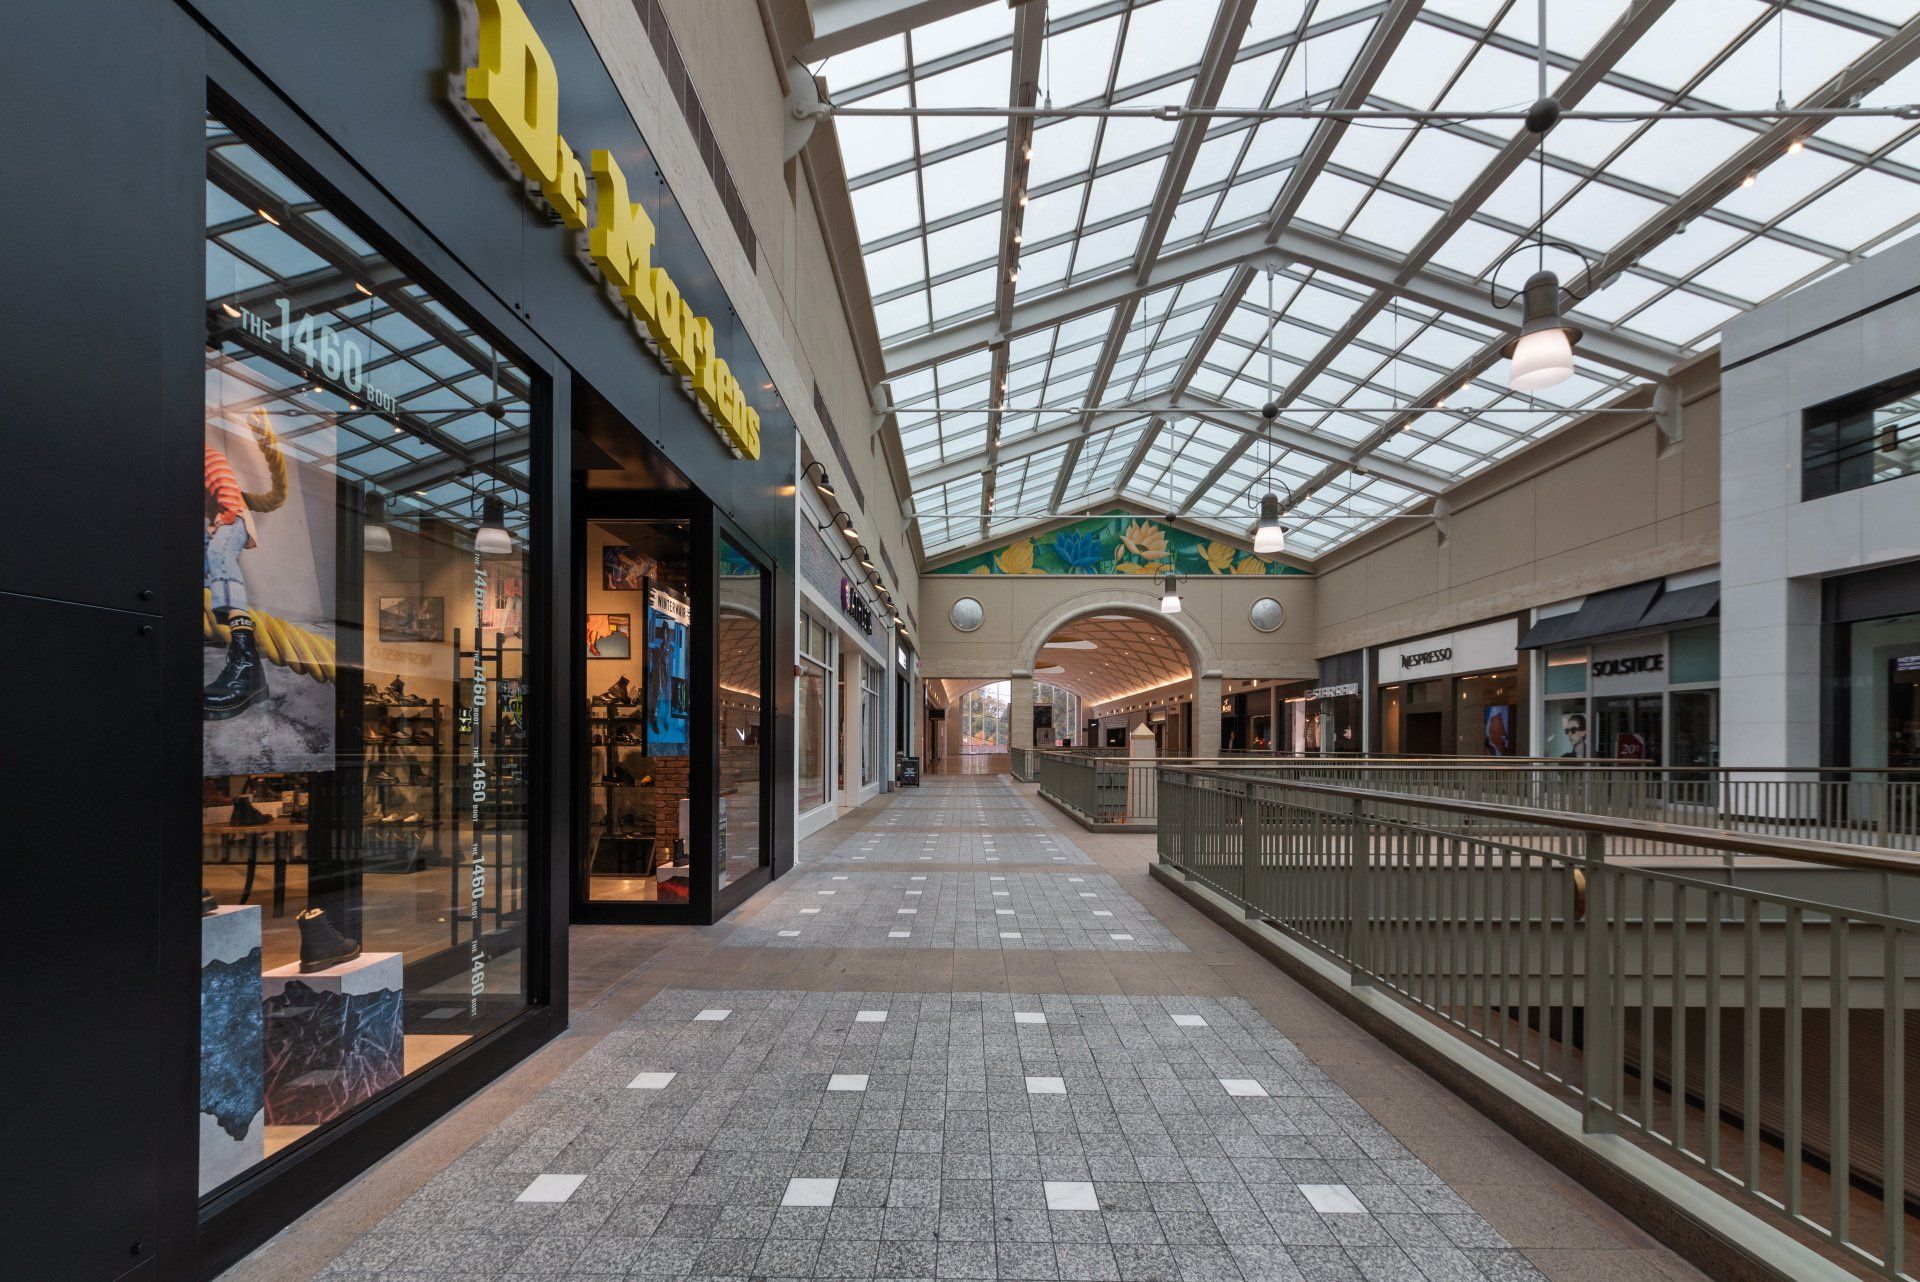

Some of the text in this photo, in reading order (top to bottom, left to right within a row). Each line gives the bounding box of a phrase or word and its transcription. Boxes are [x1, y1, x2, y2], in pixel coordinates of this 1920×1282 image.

[590, 150, 761, 461] Martens
[239, 298, 399, 415] THE 1460 BOOT
[1400, 647, 1453, 670] NESPRESSO
[1591, 653, 1665, 677] SOLSTICE
[473, 665, 487, 706] 1460
[472, 760, 487, 803] 1460
[471, 856, 486, 900] 1460
[471, 951, 485, 997] 1460
